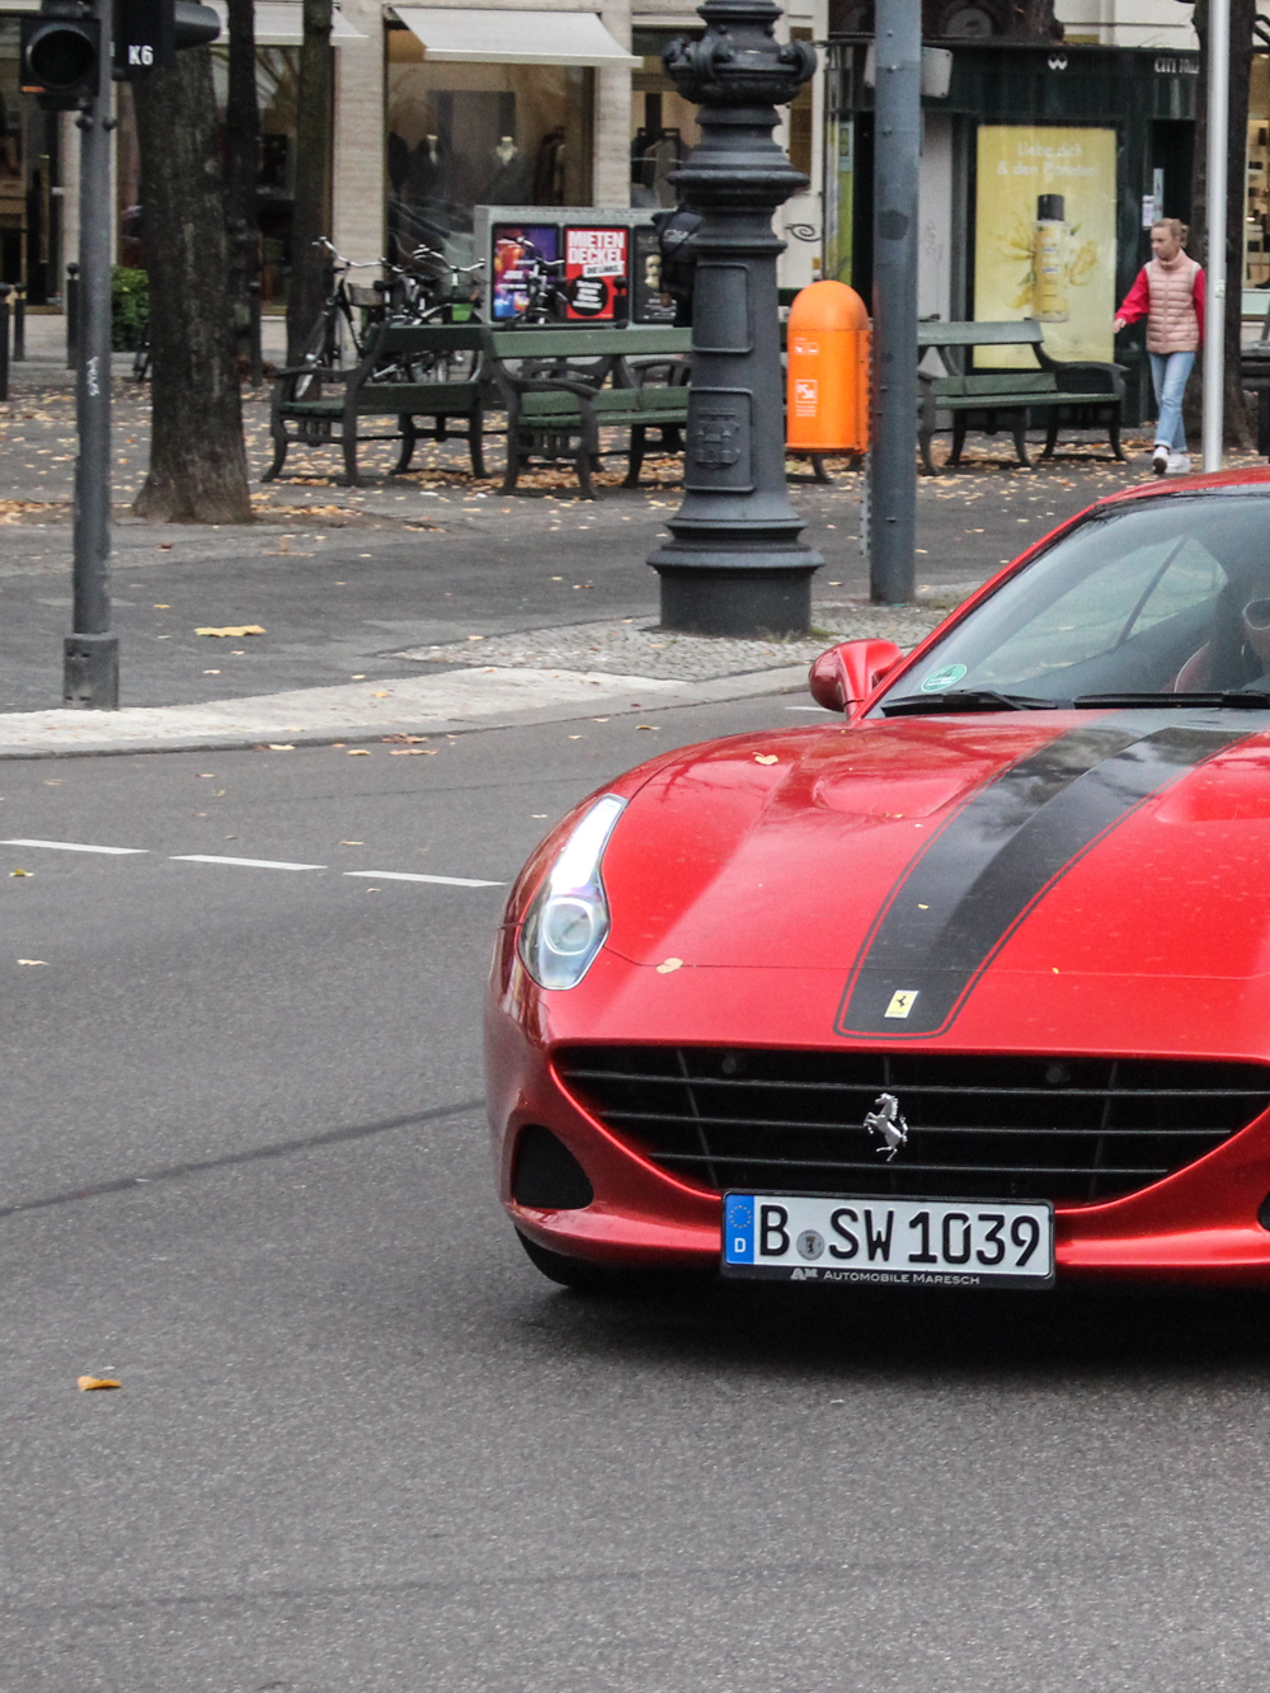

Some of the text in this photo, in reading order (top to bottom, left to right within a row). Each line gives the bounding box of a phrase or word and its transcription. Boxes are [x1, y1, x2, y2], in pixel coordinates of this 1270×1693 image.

[128, 45, 154, 66] K6
[1018, 142, 1083, 156] Liebe dich
[997, 161, 1008, 175] &
[1013, 161, 1038, 175] den
[567, 230, 625, 248] MIETEN
[567, 248, 624, 264] DECKEL
[760, 1204, 1040, 1267] B SW 1039
[734, 1237, 747, 1253] D
[824, 1270, 910, 1283] AUTOMOBILE
[913, 1273, 981, 1285] MARESCH
